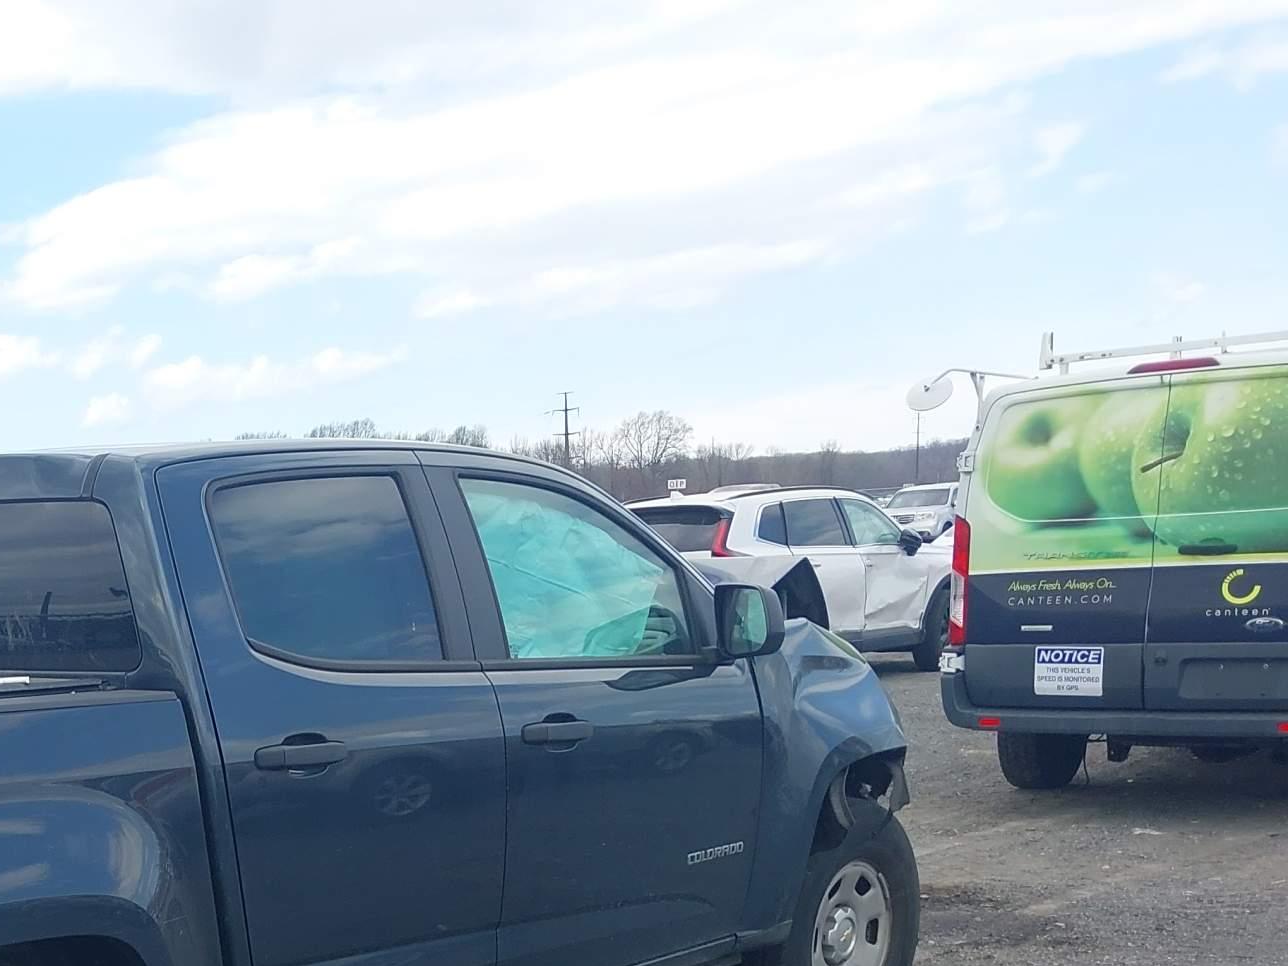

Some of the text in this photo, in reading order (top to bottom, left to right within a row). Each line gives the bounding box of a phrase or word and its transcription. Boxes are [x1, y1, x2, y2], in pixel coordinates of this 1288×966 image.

[1007, 581, 1037, 592] Always
[1064, 578, 1094, 591] Always
[1007, 594, 1112, 606] CANTEEN.COM
[1205, 607, 1269, 617] canteen
[1038, 650, 1100, 663] NOTICE
[687, 841, 744, 865] COLORADO
